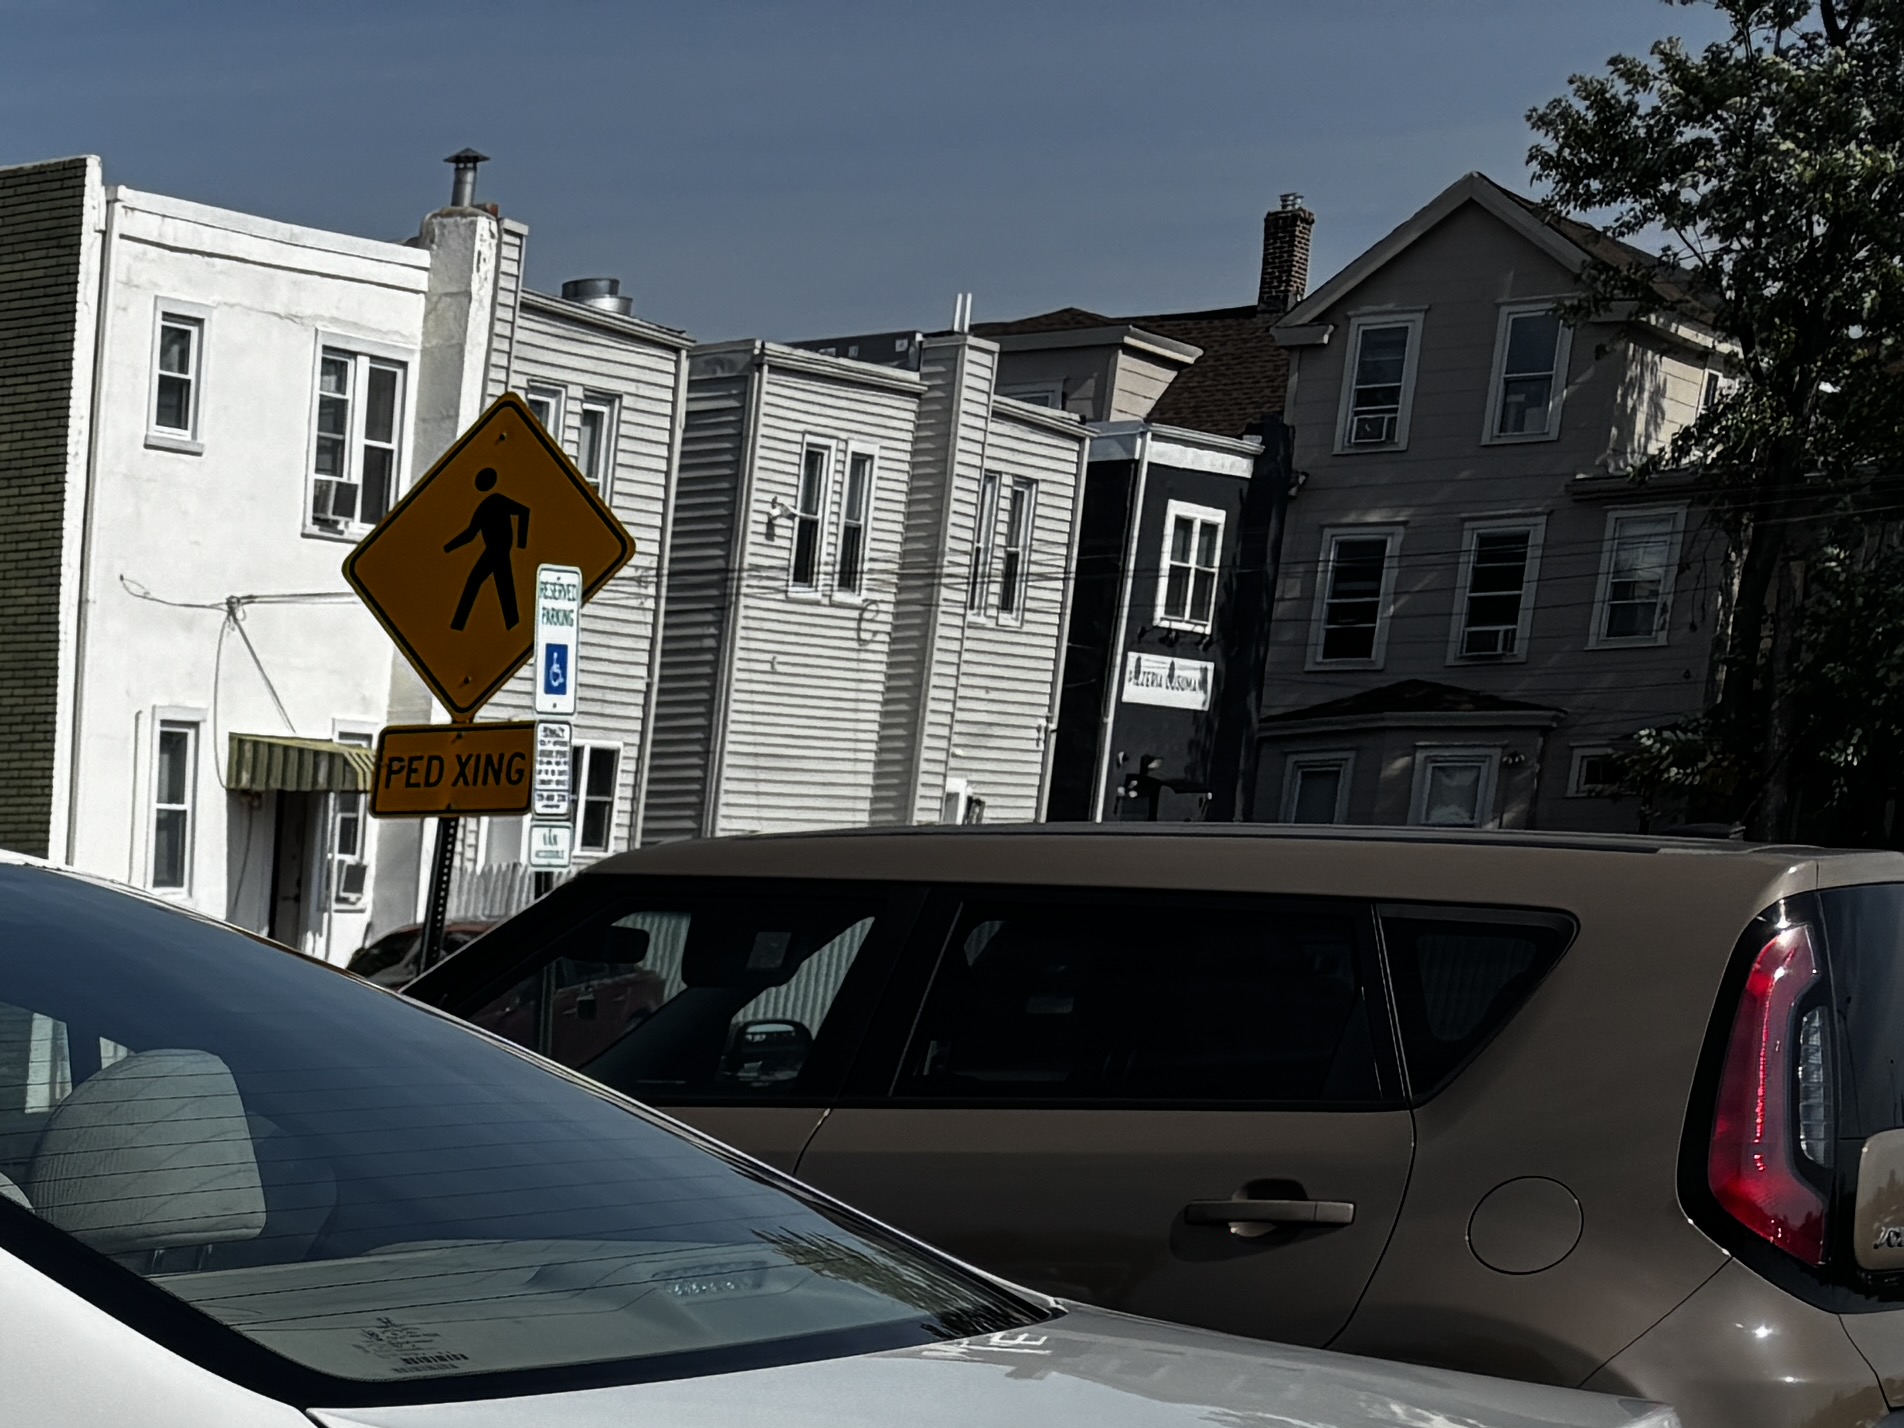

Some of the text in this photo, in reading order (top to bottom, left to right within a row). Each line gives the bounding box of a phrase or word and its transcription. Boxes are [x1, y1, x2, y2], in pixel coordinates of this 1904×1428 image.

[541, 606, 575, 628] PARKING
[384, 754, 445, 790] PED
[451, 751, 527, 788] XING
